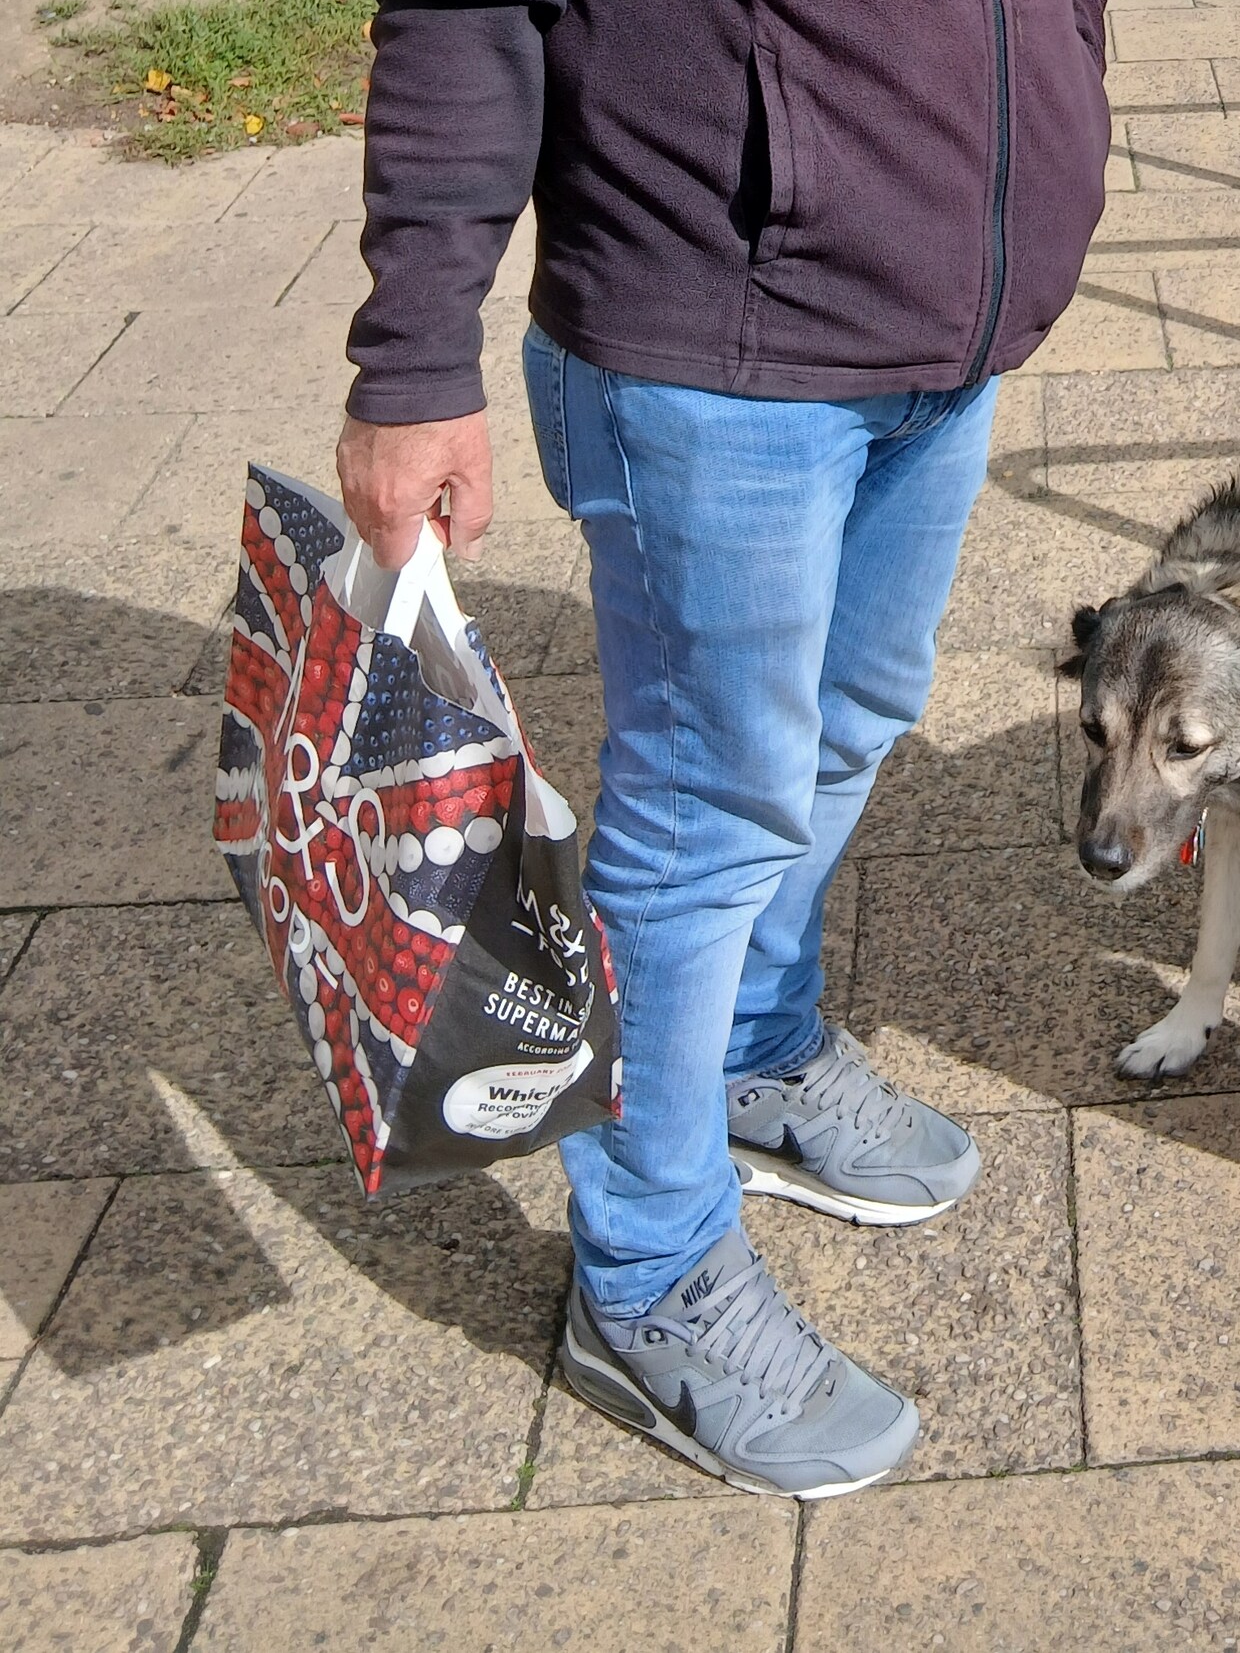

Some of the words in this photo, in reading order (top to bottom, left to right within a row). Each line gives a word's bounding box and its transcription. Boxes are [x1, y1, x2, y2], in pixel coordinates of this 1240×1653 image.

[503, 971, 556, 1011] BEST
[483, 993, 580, 1043] SUPERMA
[680, 1268, 712, 1309] NIKE
